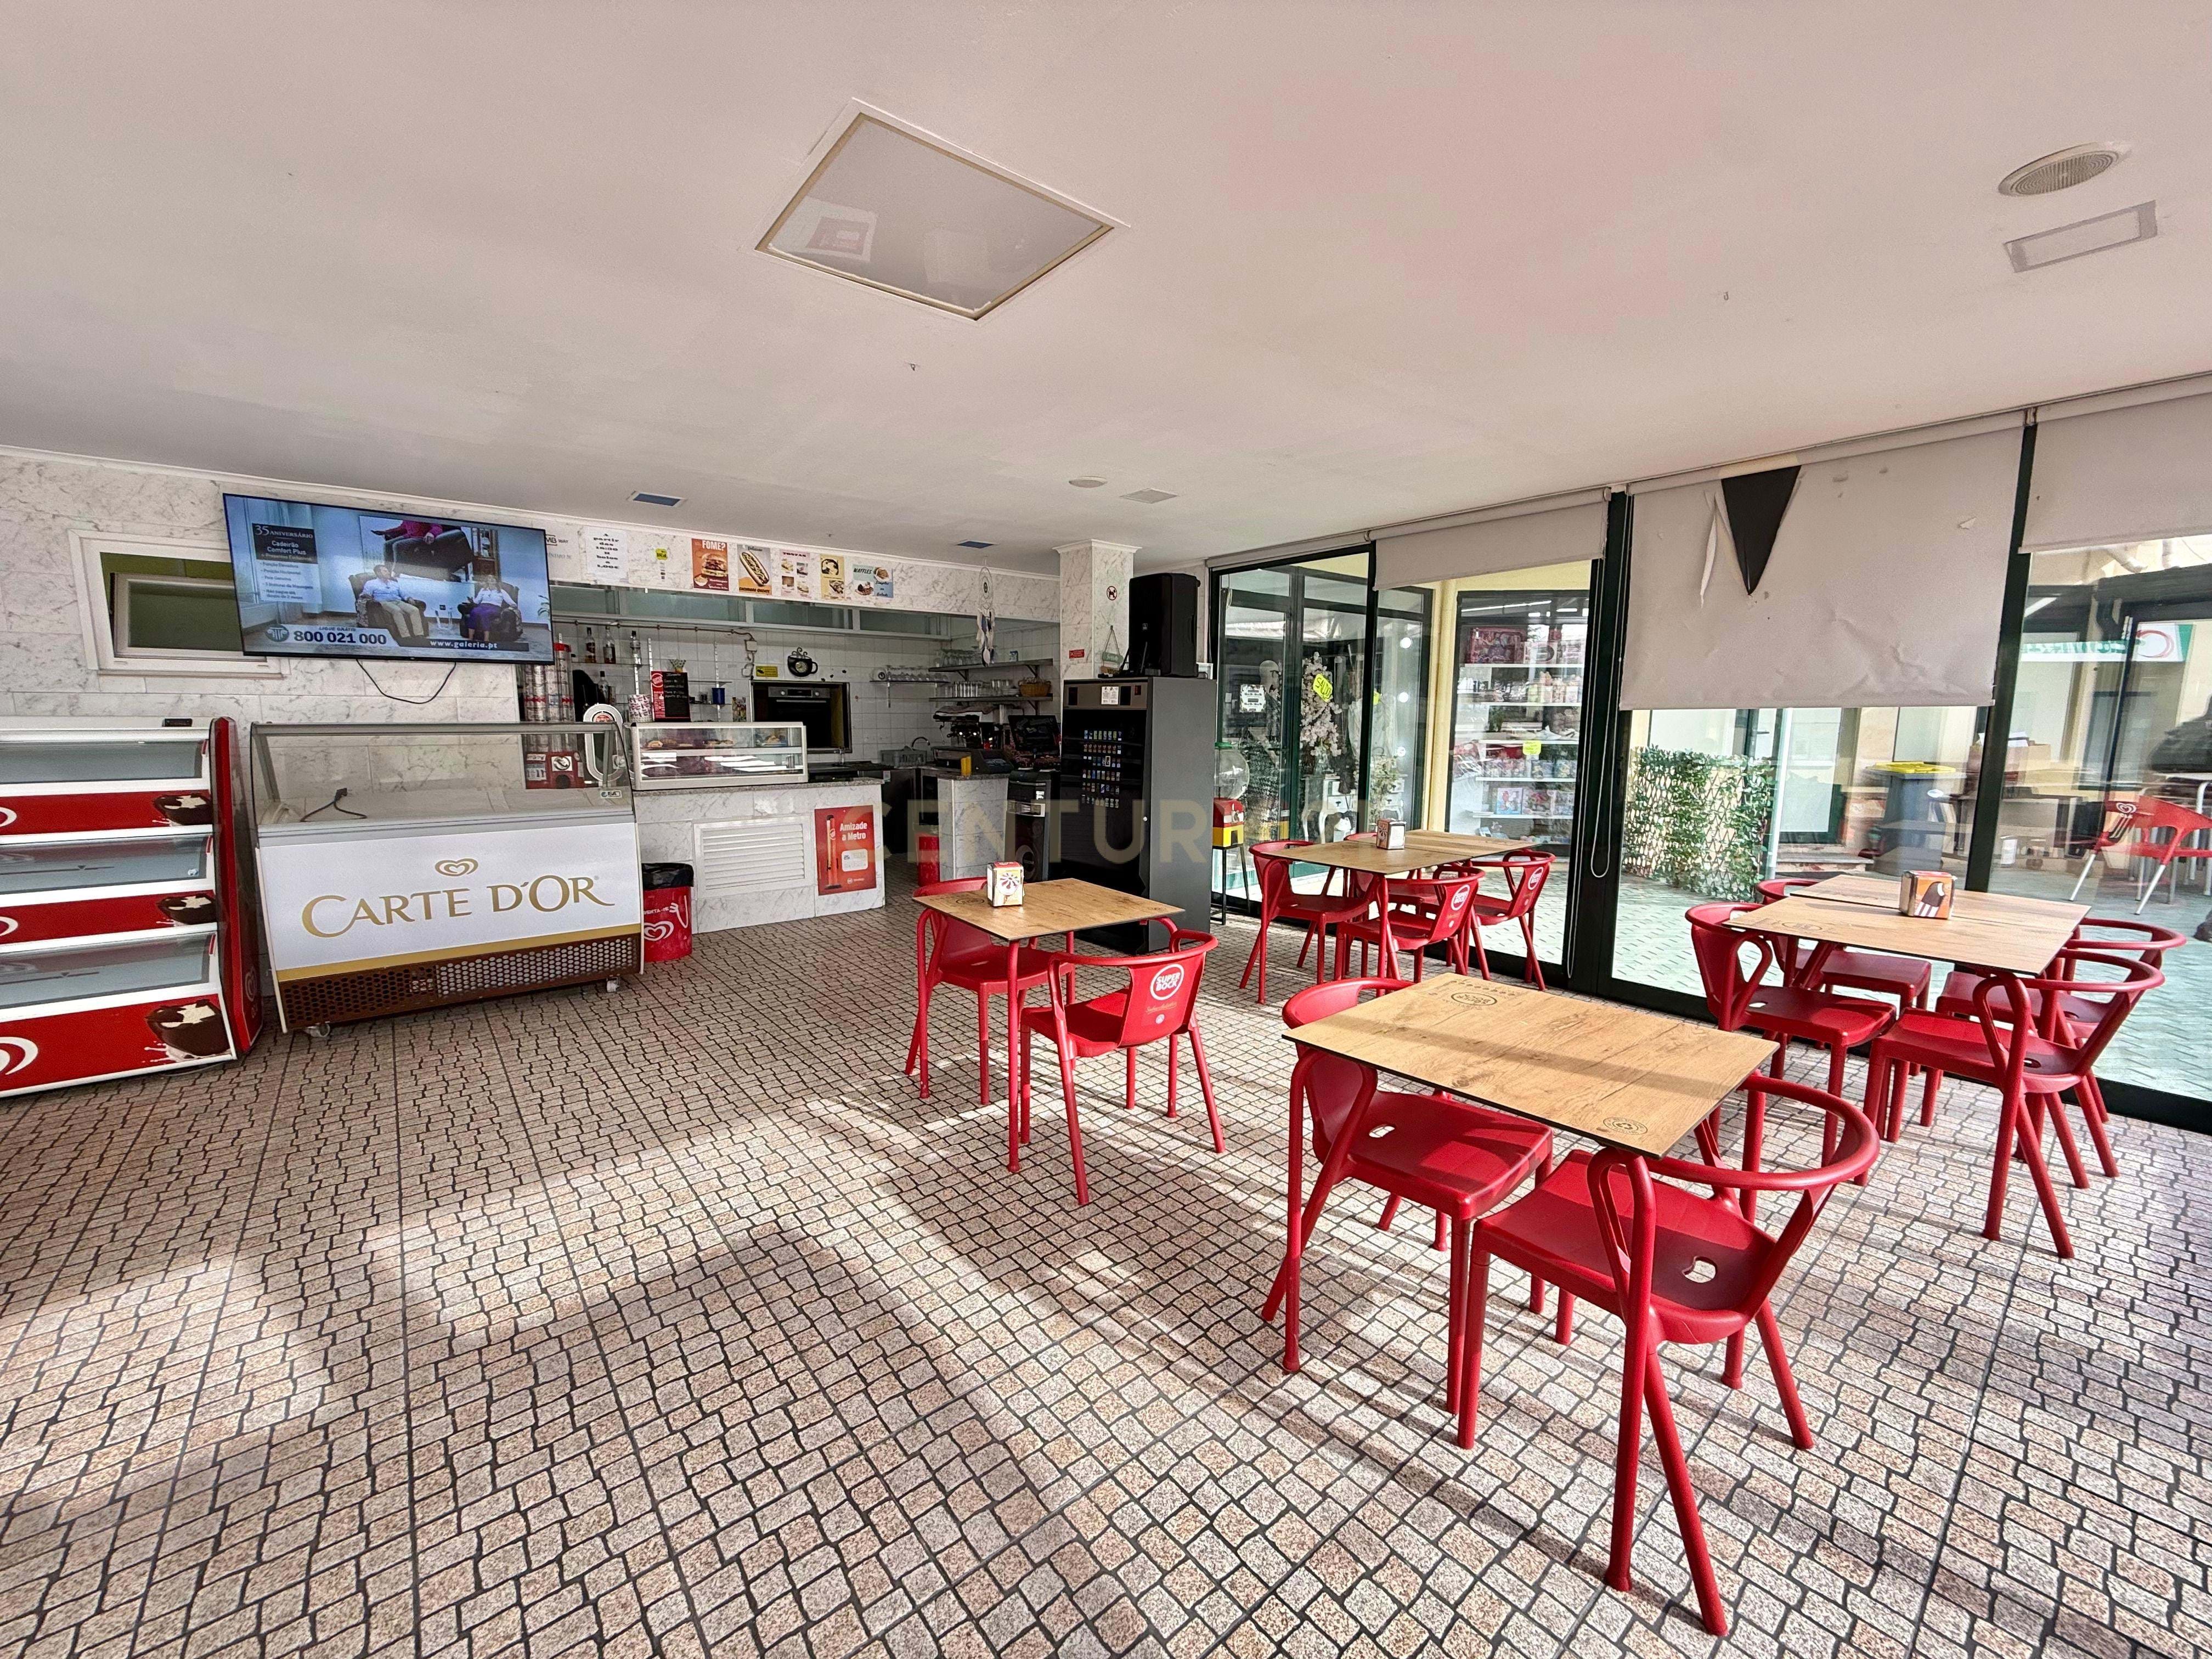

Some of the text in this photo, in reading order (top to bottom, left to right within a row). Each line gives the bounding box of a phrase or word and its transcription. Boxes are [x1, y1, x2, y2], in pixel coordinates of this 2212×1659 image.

[255, 525, 313, 538] 35 ANIVERSÁRIO
[267, 546, 291, 554] Comfort
[702, 540, 725, 551] FOME?
[294, 631, 386, 644] 800 021 000
[430, 641, 497, 650] www.galeria.pt
[840, 821, 867, 831] Amizade
[848, 831, 866, 840] Metro
[301, 874, 616, 938] CARTE D'OR
[1156, 972, 1181, 984] SUPER
[1155, 979, 1178, 991] BOCK
